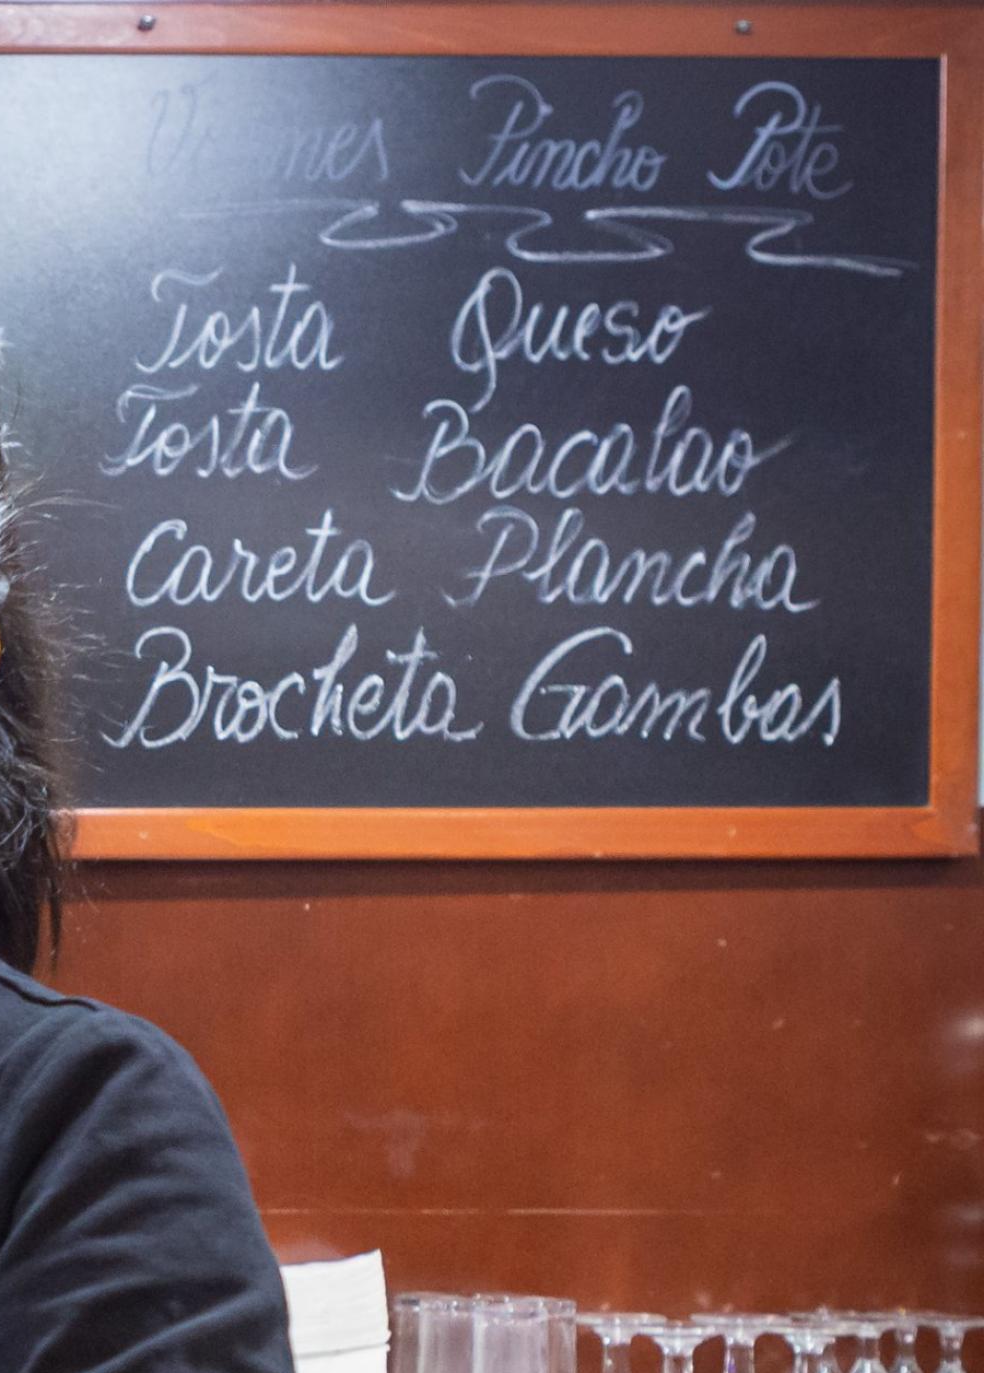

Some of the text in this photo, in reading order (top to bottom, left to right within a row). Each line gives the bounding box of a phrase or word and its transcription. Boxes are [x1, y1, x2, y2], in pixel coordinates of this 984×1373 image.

[460, 74, 666, 193] Pincho
[707, 81, 854, 200] Pote
[135, 262, 714, 413] Tosta Queso
[100, 381, 792, 504] Tosta Bacalao
[125, 505, 818, 613] Careta Plancha
[105, 622, 842, 750] Brocheta Gambas
